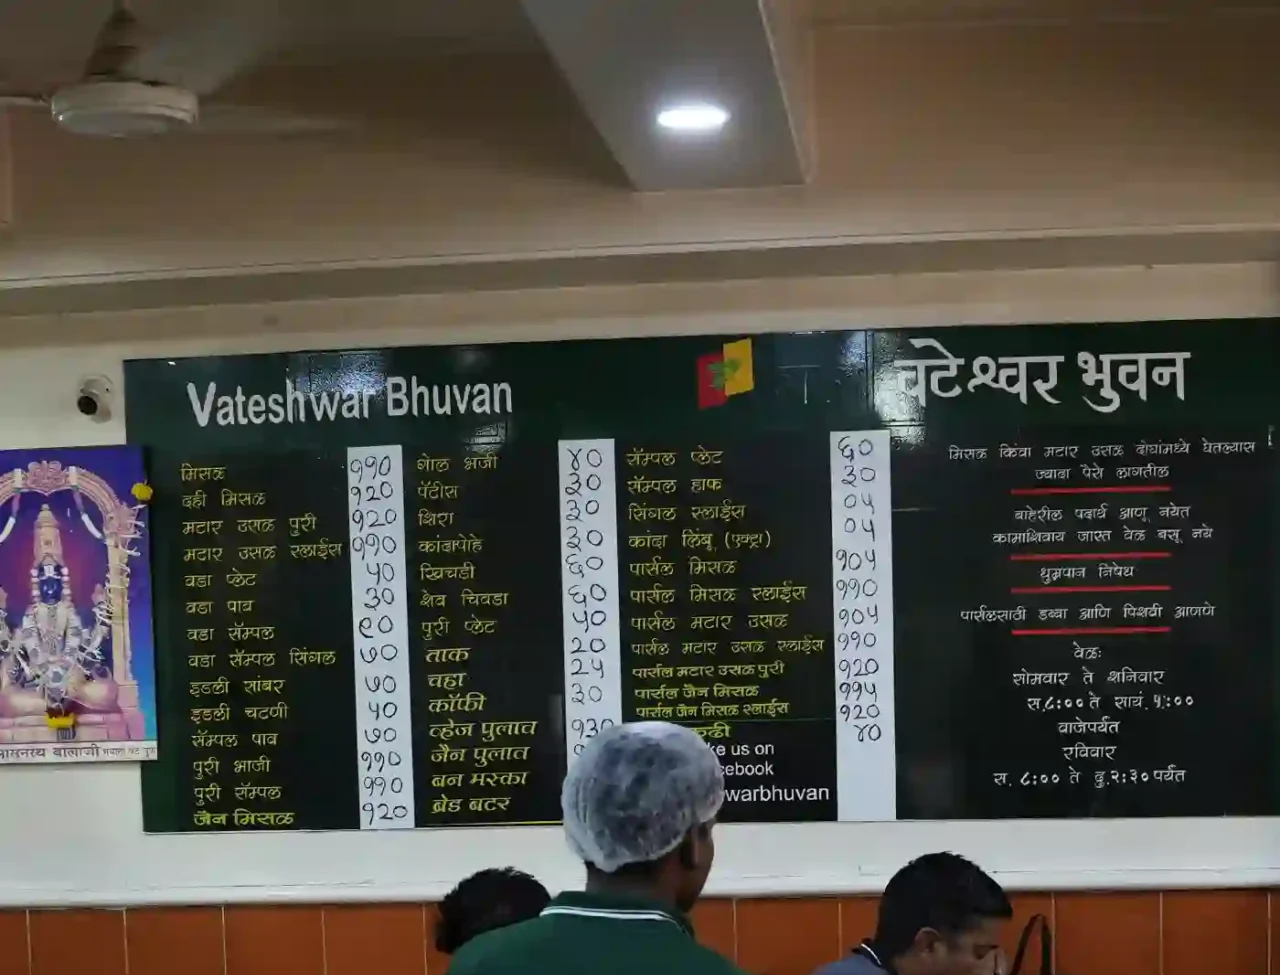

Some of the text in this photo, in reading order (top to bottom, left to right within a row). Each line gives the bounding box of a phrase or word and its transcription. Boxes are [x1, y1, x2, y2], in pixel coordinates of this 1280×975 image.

[898, 338, 1191, 413] वटेश्वर भुवन
[186, 376, 513, 428] Vateshwar Bhuvan
[626, 445, 723, 466] सॅम्पल प्लेट
[949, 445, 987, 459] मिसळ
[999, 444, 1031, 457] किंवा
[1044, 446, 1078, 458] मटार
[1092, 445, 1123, 456] उसळ
[181, 463, 225, 481] मिसळ
[1117, 463, 1169, 478] लागतील
[627, 476, 722, 493] सॅम्पल हाफ
[183, 489, 265, 508] दही मिसळ
[1015, 505, 1062, 522] बाहेरील
[1075, 503, 1108, 519] पदार्थ
[1159, 502, 1190, 518] नयेत
[183, 513, 316, 536] मटार उसळ पुरी
[629, 530, 668, 548] कांदा
[993, 524, 1213, 544] कामाशिवाय जास्त वेळ बसू नये
[184, 548, 223, 561] मटार
[239, 546, 276, 559] उसळ
[420, 562, 475, 580] खिचडी
[630, 556, 737, 576] पार्सल मिसळ
[185, 568, 257, 587] वडा प्लेट
[461, 589, 508, 605] चिवडा
[631, 583, 675, 603] पार्सल
[689, 584, 736, 601] मिसळ
[186, 601, 254, 614] वडा पाव
[1080, 604, 1111, 620] आणि
[1124, 603, 1163, 618] पिशवी
[1175, 602, 1215, 618] आणणे
[422, 614, 497, 640] पुरी प्लेट
[632, 611, 788, 630] पार्सल मटार उसळ
[187, 622, 274, 640] वडा सॅम्पल
[426, 648, 470, 662] ताक
[732, 641, 765, 652] उसळ
[189, 648, 335, 667] वडा सॅम्पल सिंगल
[633, 660, 784, 678] पार्सल मटार उसळ पुरी
[1013, 666, 1164, 685] सोमवार ते शनिवार
[190, 676, 286, 697] इडली सांबर
[428, 673, 466, 690] चहा
[635, 683, 759, 699] पार्सल जैन मिसळ
[1089, 691, 1100, 708] ते
[429, 692, 486, 712] कॉफी
[701, 702, 739, 716] मिसळ
[191, 702, 287, 724] इडली चटणी
[191, 730, 278, 747] सॅम्पल पाव
[430, 719, 537, 741] व्हेज पुलाव
[431, 744, 530, 767] जैन पुलाव
[731, 743, 774, 756] us on
[1062, 742, 1116, 760] रविवार
[194, 755, 270, 779] पुरी भाजी
[1069, 766, 1080, 783] ते
[432, 772, 528, 787] बन मस्का
[194, 783, 281, 805] पुरी सॅम्पल
[432, 794, 511, 813] ब्रेड बटर
[194, 808, 294, 825] जैन मिसळ
